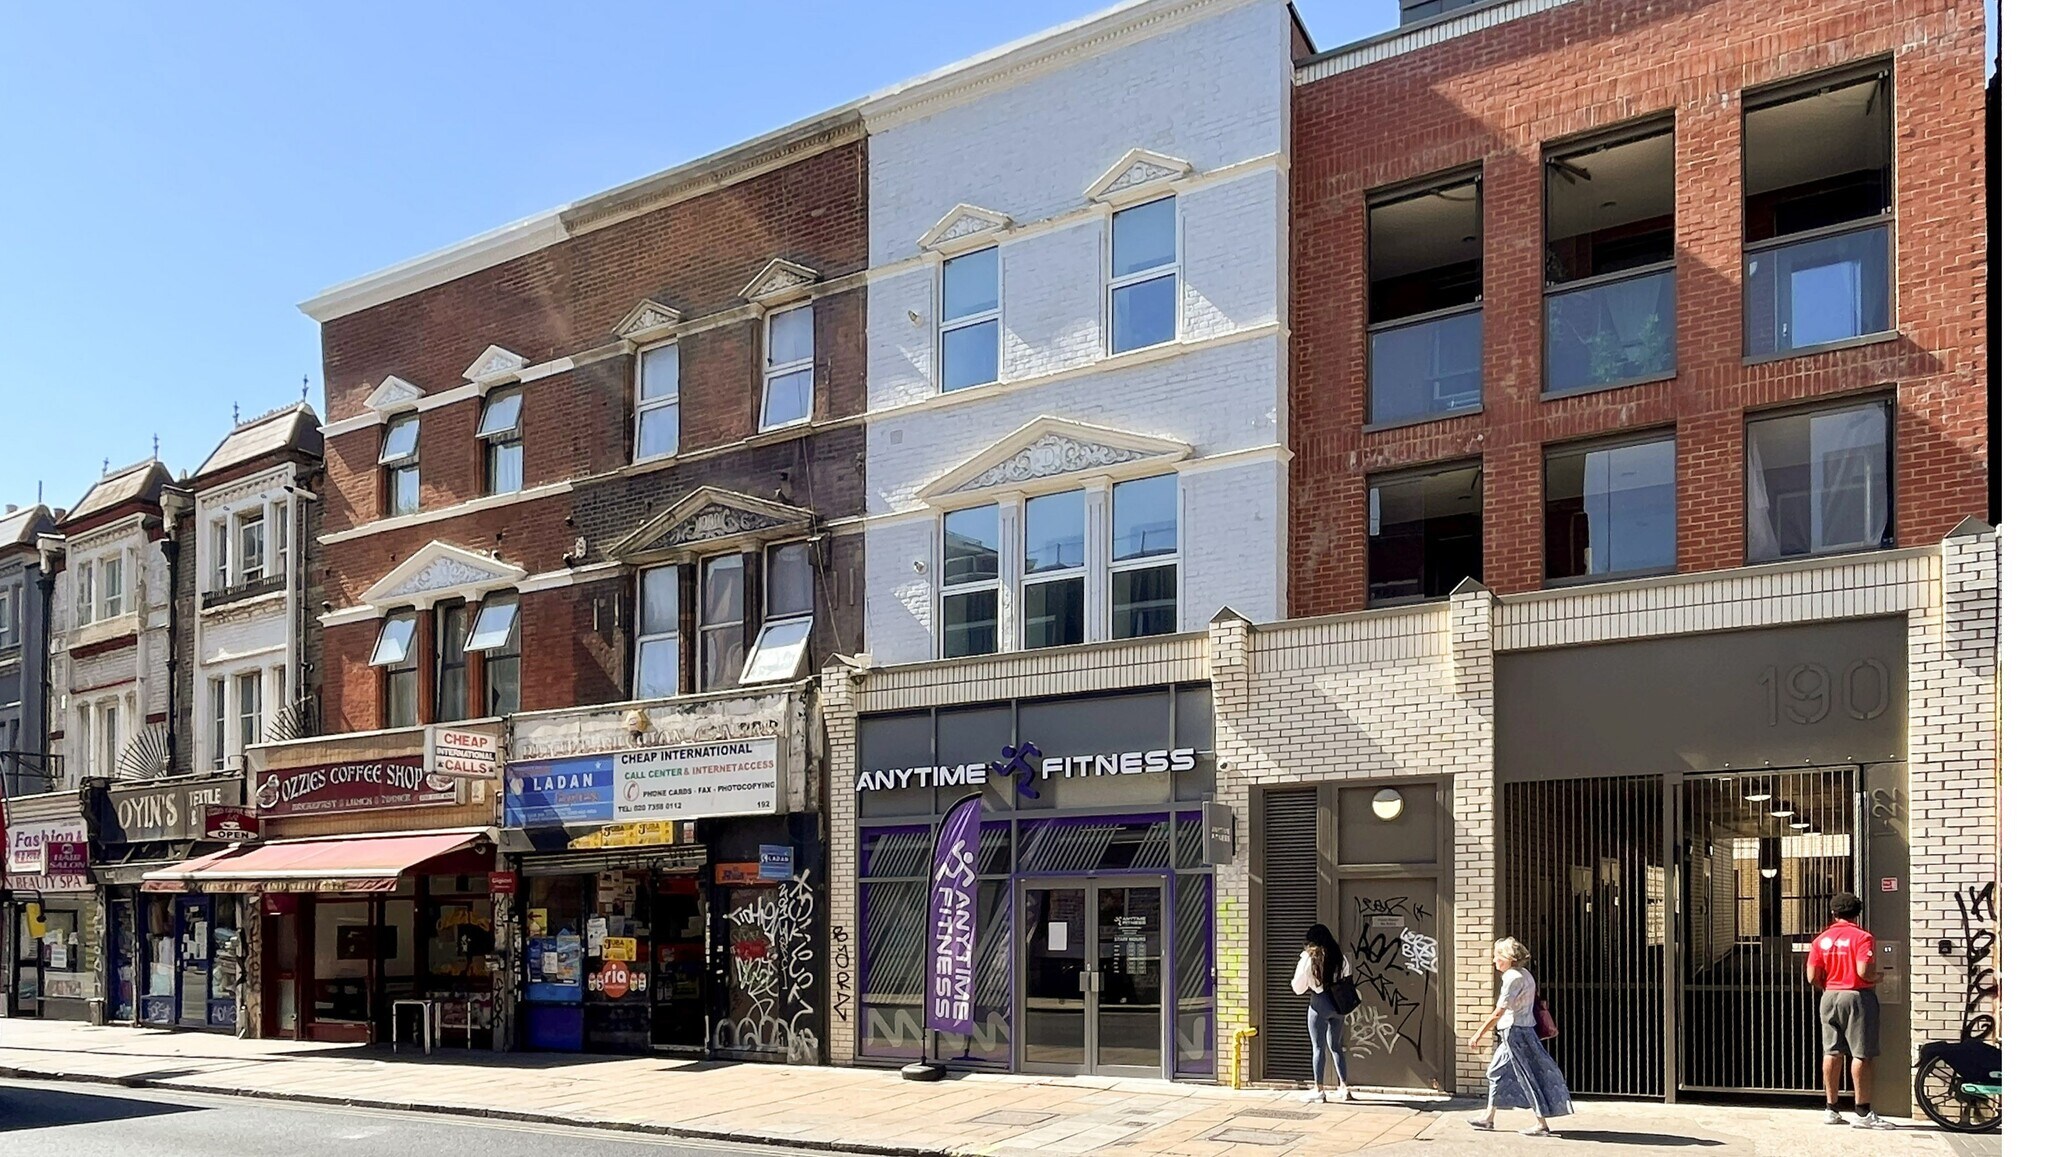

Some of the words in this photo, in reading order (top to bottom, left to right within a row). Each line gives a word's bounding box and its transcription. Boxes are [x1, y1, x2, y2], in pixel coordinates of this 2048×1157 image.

[1757, 656, 1890, 728] 190
[444, 733, 488, 748] CHEAP
[436, 747, 494, 760] INTERNATIONAL
[621, 752, 657, 765] CHEAP
[660, 743, 753, 762] INTERNATIONAL
[444, 759, 487, 774] CALLS
[624, 771, 645, 780] CALL
[648, 768, 682, 779] CENTER
[683, 768, 690, 776] &
[855, 763, 987, 792] ANYTIME
[1041, 747, 1196, 780] FITNESS
[281, 769, 327, 802] OZZIES
[330, 764, 382, 784] COFFEE
[386, 764, 423, 791] SHOP
[533, 772, 593, 791] LADAN
[643, 790, 667, 798] PHONE
[118, 793, 179, 829] OYIN'S
[218, 831, 249, 839] OPEN
[60, 875, 82, 889] SPA
[934, 887, 954, 1019] FITNESS
[952, 889, 972, 1021] ANYTIME
[604, 963, 627, 984] ria
